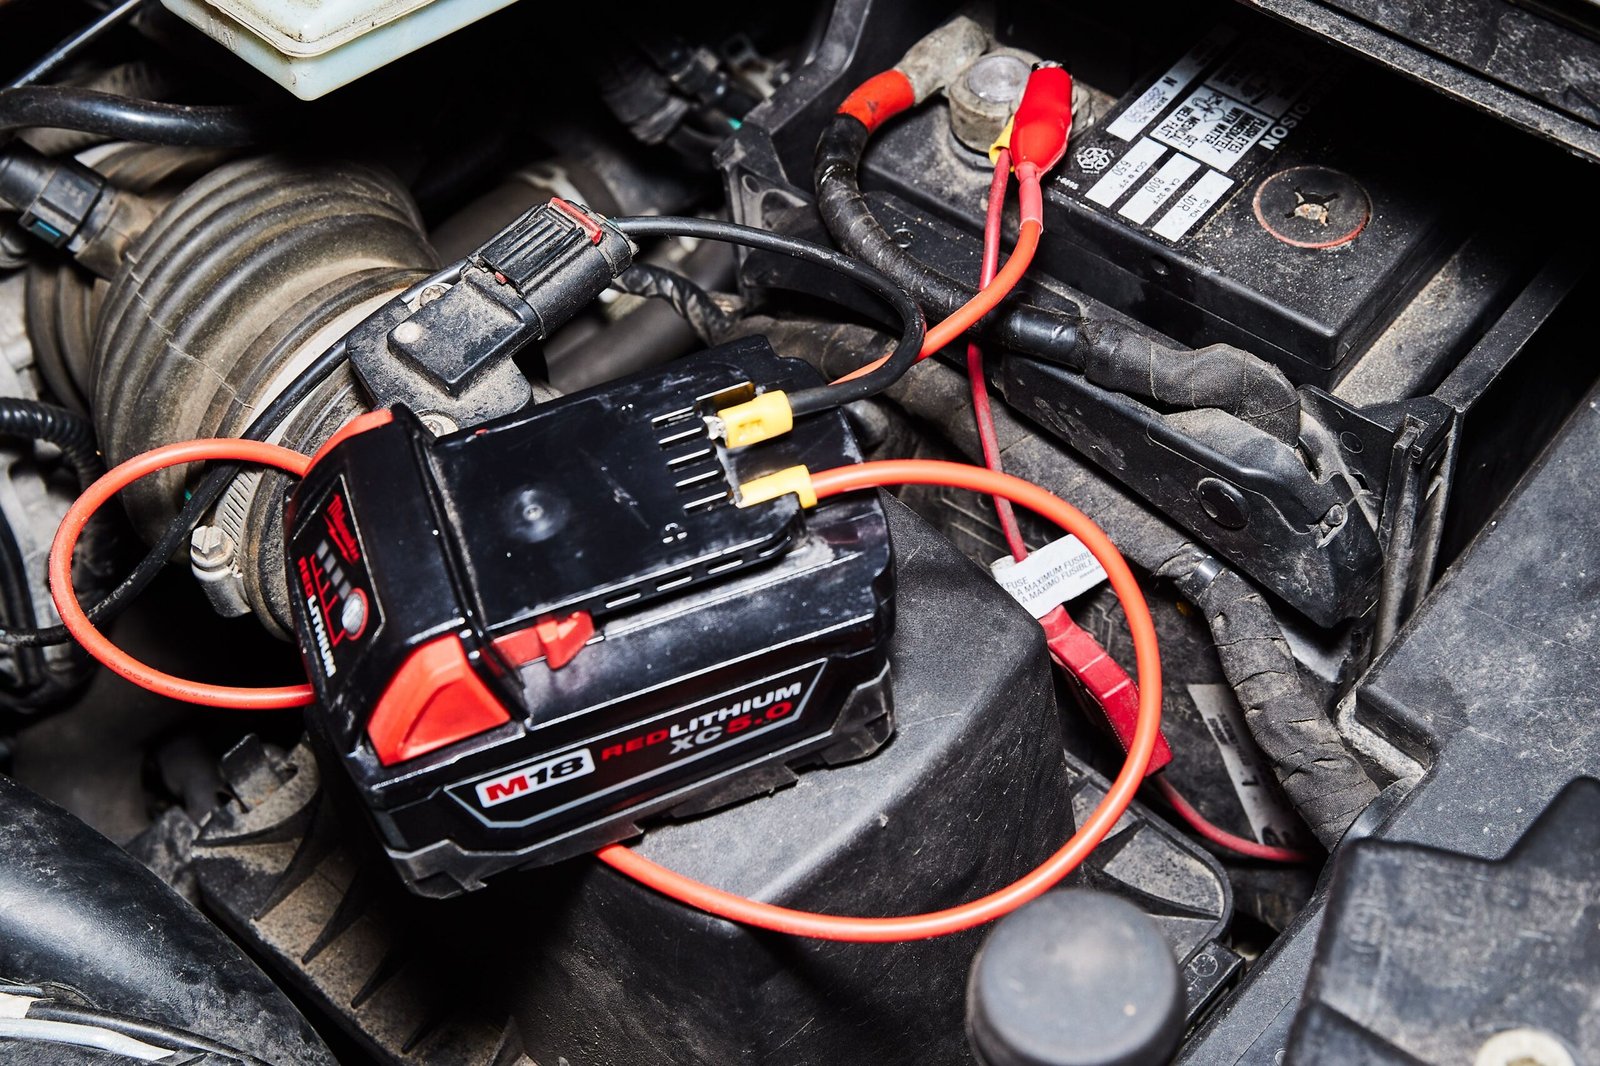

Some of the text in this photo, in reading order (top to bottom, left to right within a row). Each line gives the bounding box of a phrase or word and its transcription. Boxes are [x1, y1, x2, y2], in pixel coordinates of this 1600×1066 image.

[1175, 105, 1194, 121] HELP
[1222, 107, 1246, 125] WITH
[1167, 116, 1201, 139] MEDICAL
[1258, 96, 1317, 151] OISON
[1228, 137, 1249, 153] EYES
[1112, 160, 1132, 176] 650
[1145, 177, 1165, 193] 800
[1176, 194, 1197, 212] 40R
[1024, 565, 1063, 592] MAXIMUM
[1063, 551, 1091, 570] FUSIBL
[1029, 577, 1061, 600] MAXIMO
[1061, 559, 1094, 580] FUSIBLE
[1006, 576, 1028, 590] FUSE
[298, 556, 337, 678] REDLITHIUM
[602, 681, 802, 762] REDLITHIUM
[485, 755, 584, 801] M18
